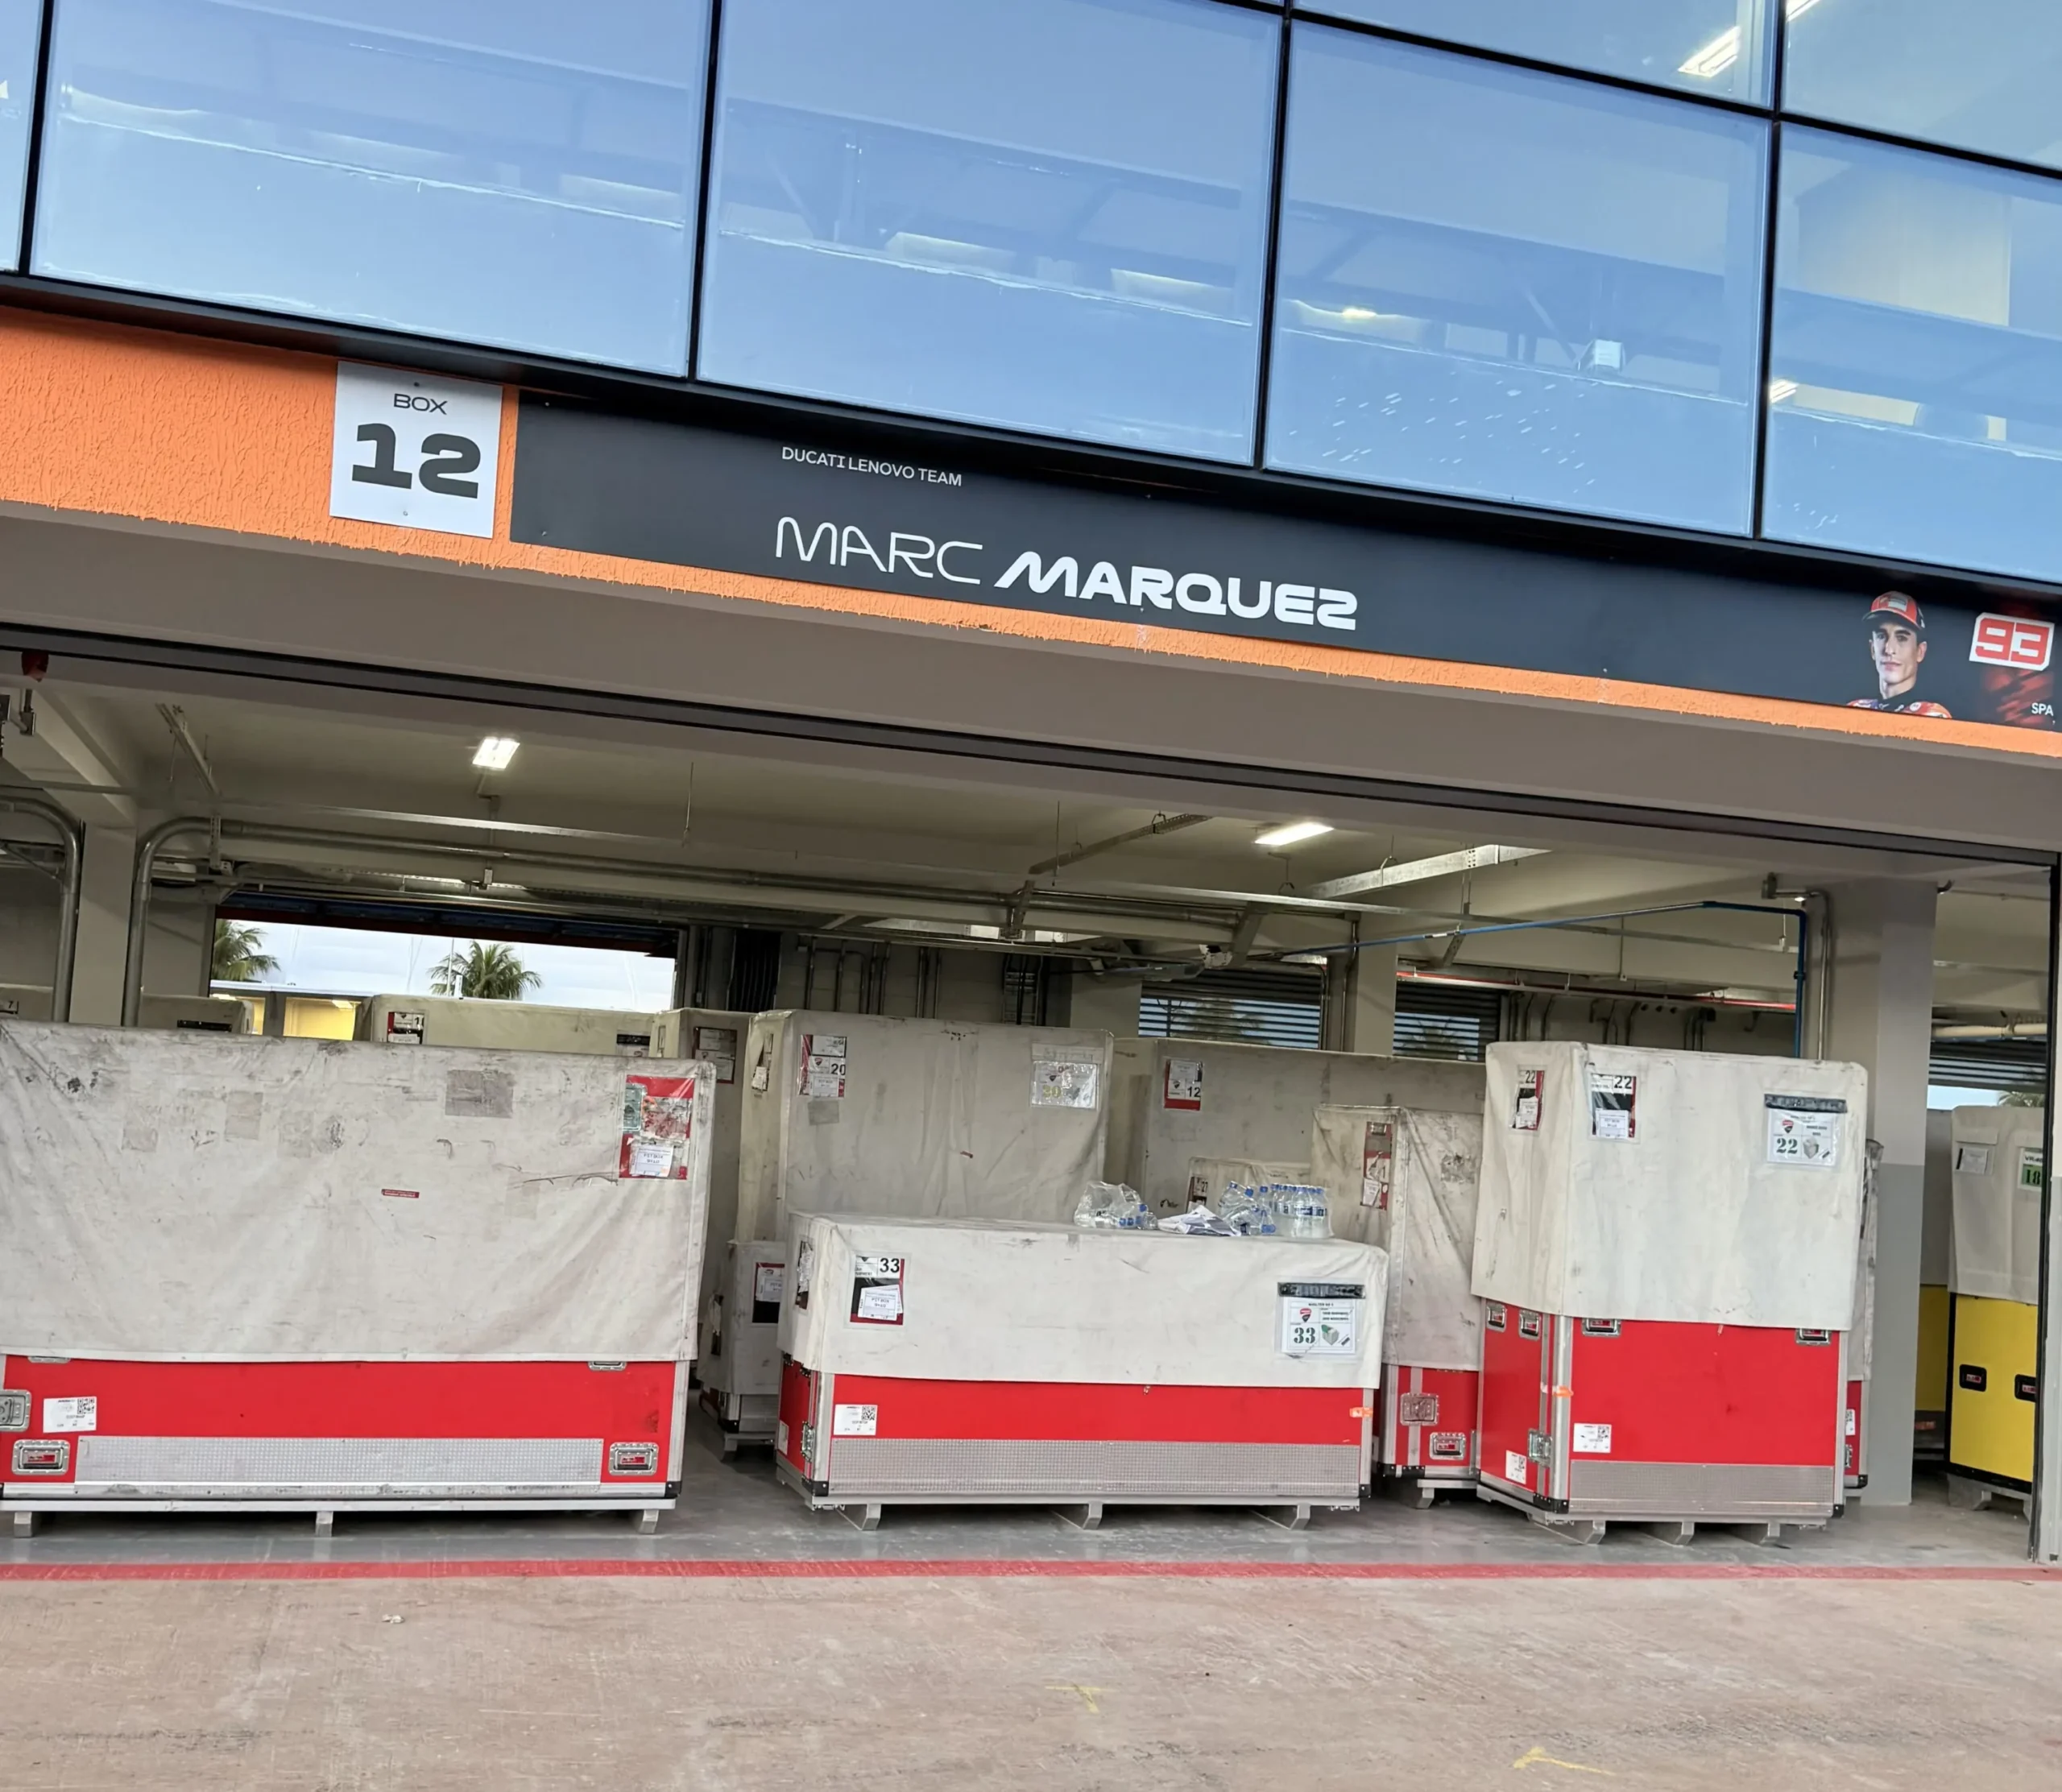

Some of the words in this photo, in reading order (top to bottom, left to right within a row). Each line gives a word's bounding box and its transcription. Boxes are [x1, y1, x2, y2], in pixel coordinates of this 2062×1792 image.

[393, 392, 448, 416] BOX
[352, 422, 482, 499] 12
[781, 446, 846, 470] DUCATI
[848, 457, 915, 479] LENOVO
[917, 468, 962, 486] TEAM
[776, 516, 983, 585] MARC
[1975, 617, 2051, 665] 93
[2031, 702, 2055, 717] SPA
[831, 1063, 846, 1076] 20
[1525, 1070, 1536, 1084] 22
[1613, 1075, 1632, 1089] 22
[1187, 1086, 1201, 1098] 12
[1776, 1137, 1798, 1154] 22
[880, 1257, 900, 1273] 33
[1294, 1326, 1316, 1344] 33
